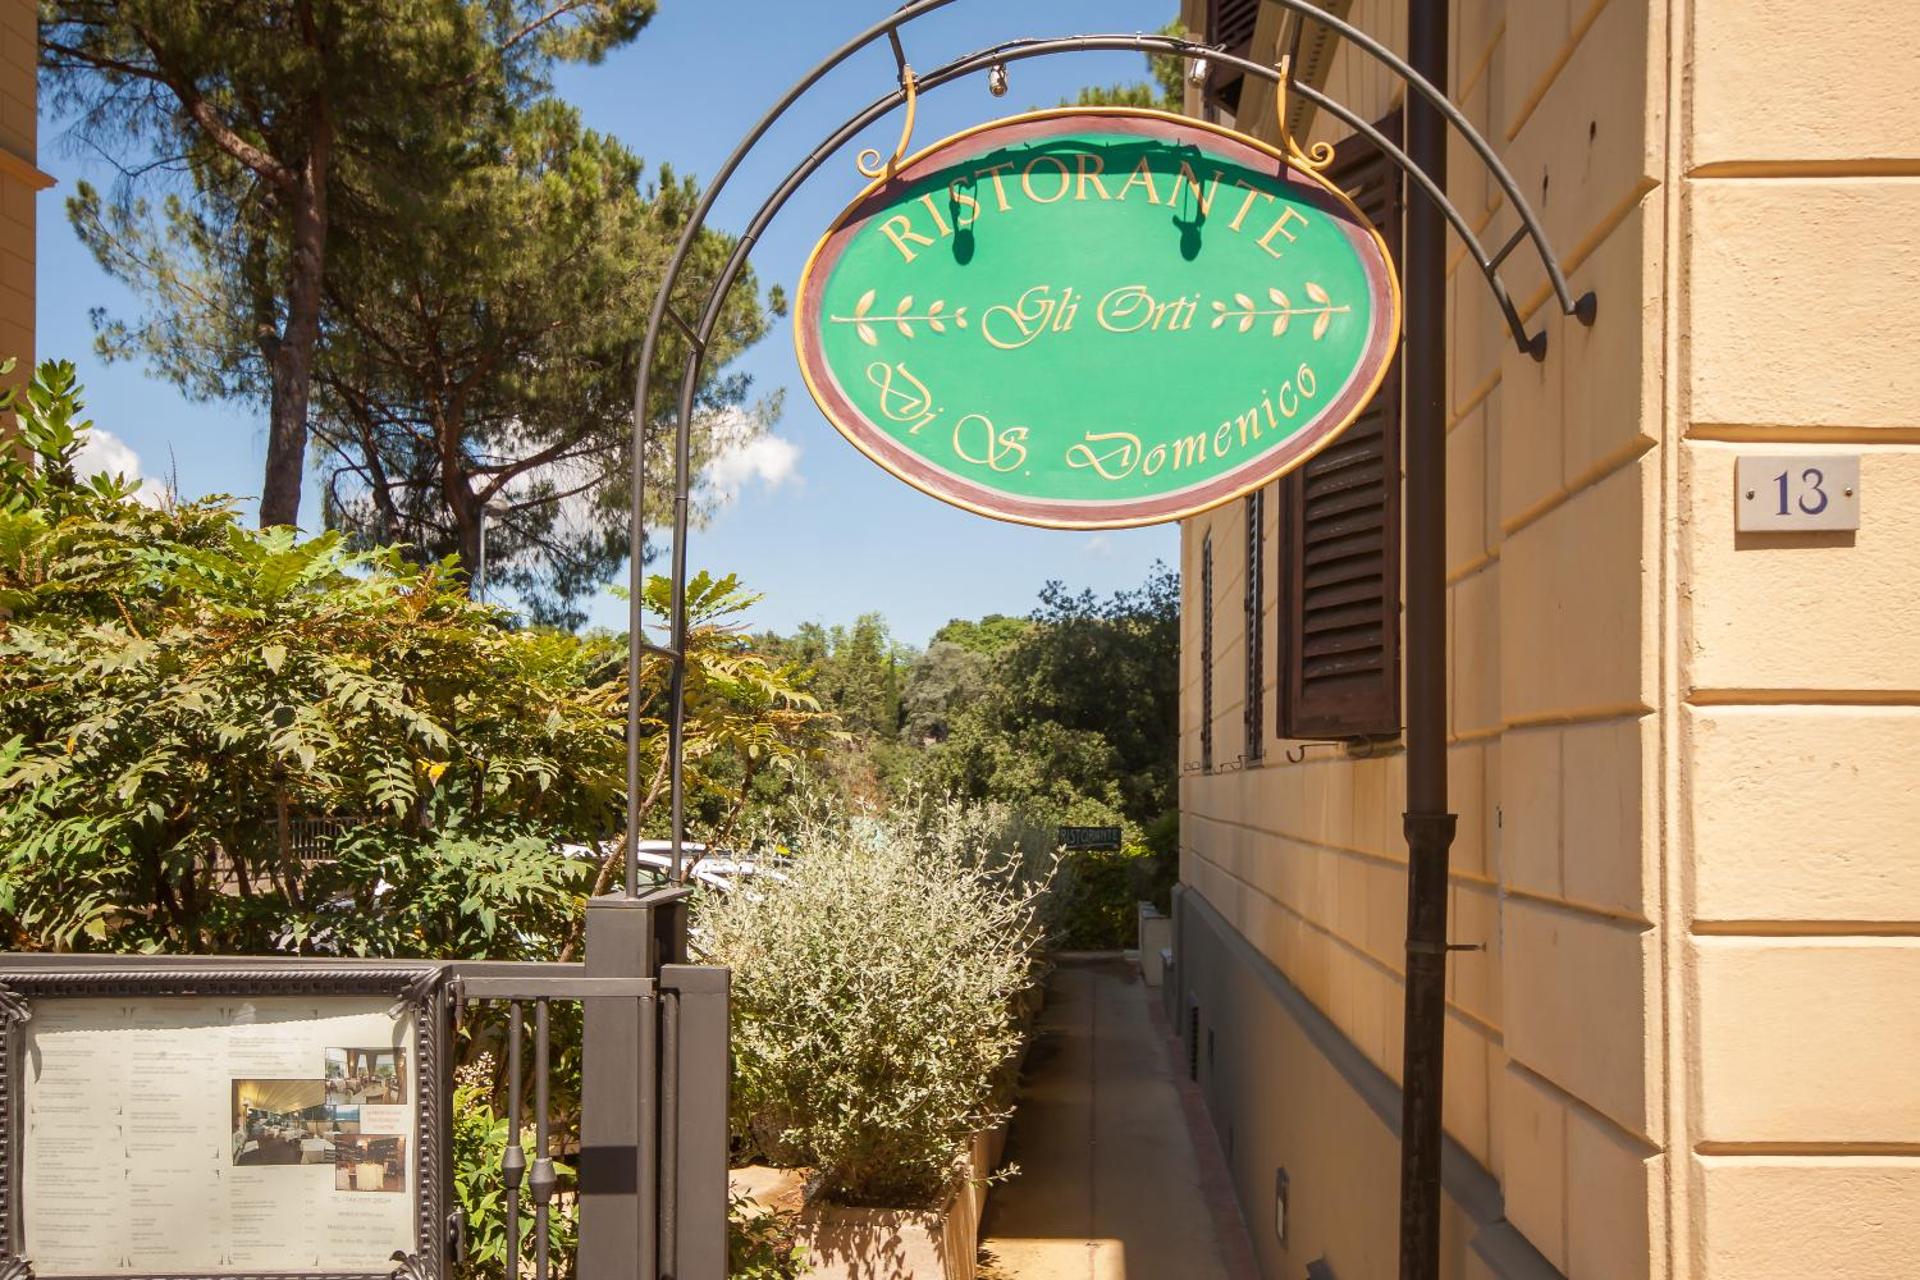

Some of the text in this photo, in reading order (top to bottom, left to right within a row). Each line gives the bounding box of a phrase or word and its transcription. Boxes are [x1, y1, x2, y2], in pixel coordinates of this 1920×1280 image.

[879, 153, 1309, 264] RISTORANTE
[981, 284, 1203, 349] Gli Orti
[866, 361, 1317, 481] Di S. Domenico
[1772, 467, 1829, 516] 13
